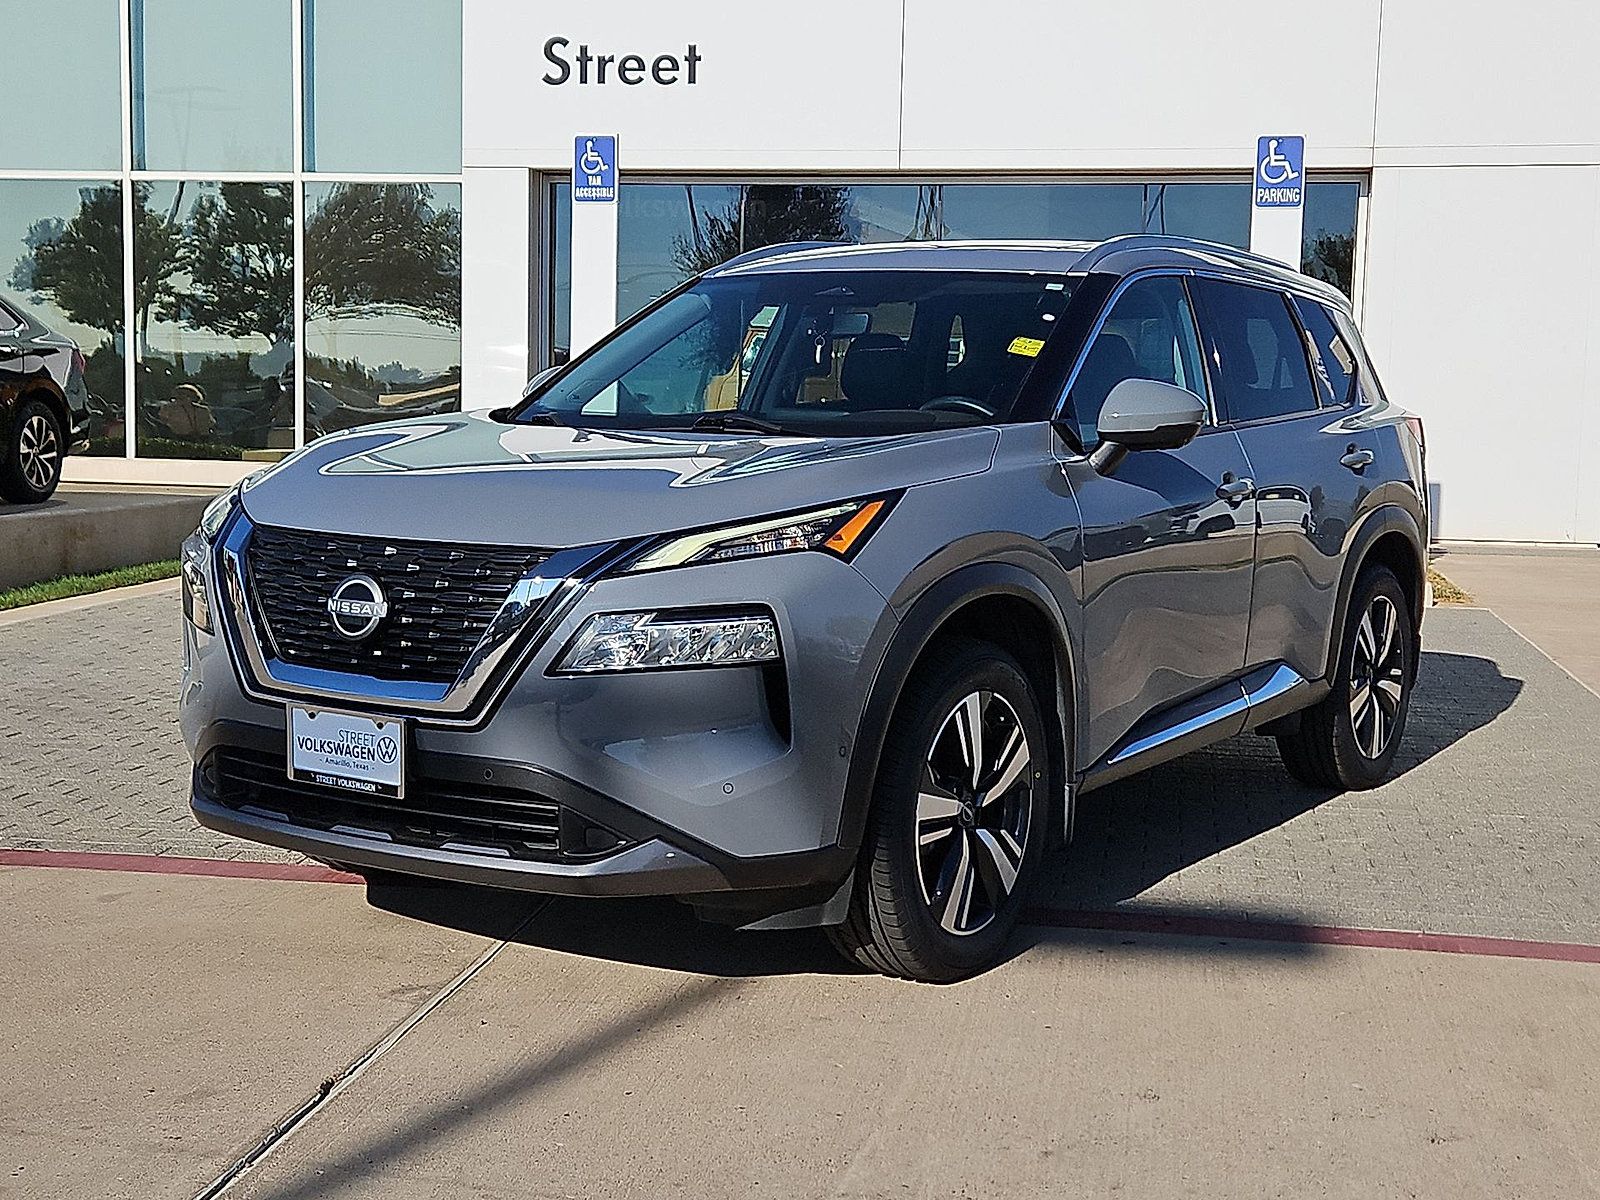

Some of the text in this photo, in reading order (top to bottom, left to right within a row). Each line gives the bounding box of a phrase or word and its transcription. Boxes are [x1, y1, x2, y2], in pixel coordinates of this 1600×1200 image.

[541, 36, 702, 86] Street
[575, 186, 614, 198] ACCESSIBLE
[1256, 187, 1301, 203] PARKING
[327, 597, 385, 616] NISSAN
[338, 729, 376, 747] STREET
[297, 735, 376, 761] VOLKSWAGEN
[353, 761, 369, 771] Texas
[316, 774, 376, 792] STREET VOLKSWAGEN
